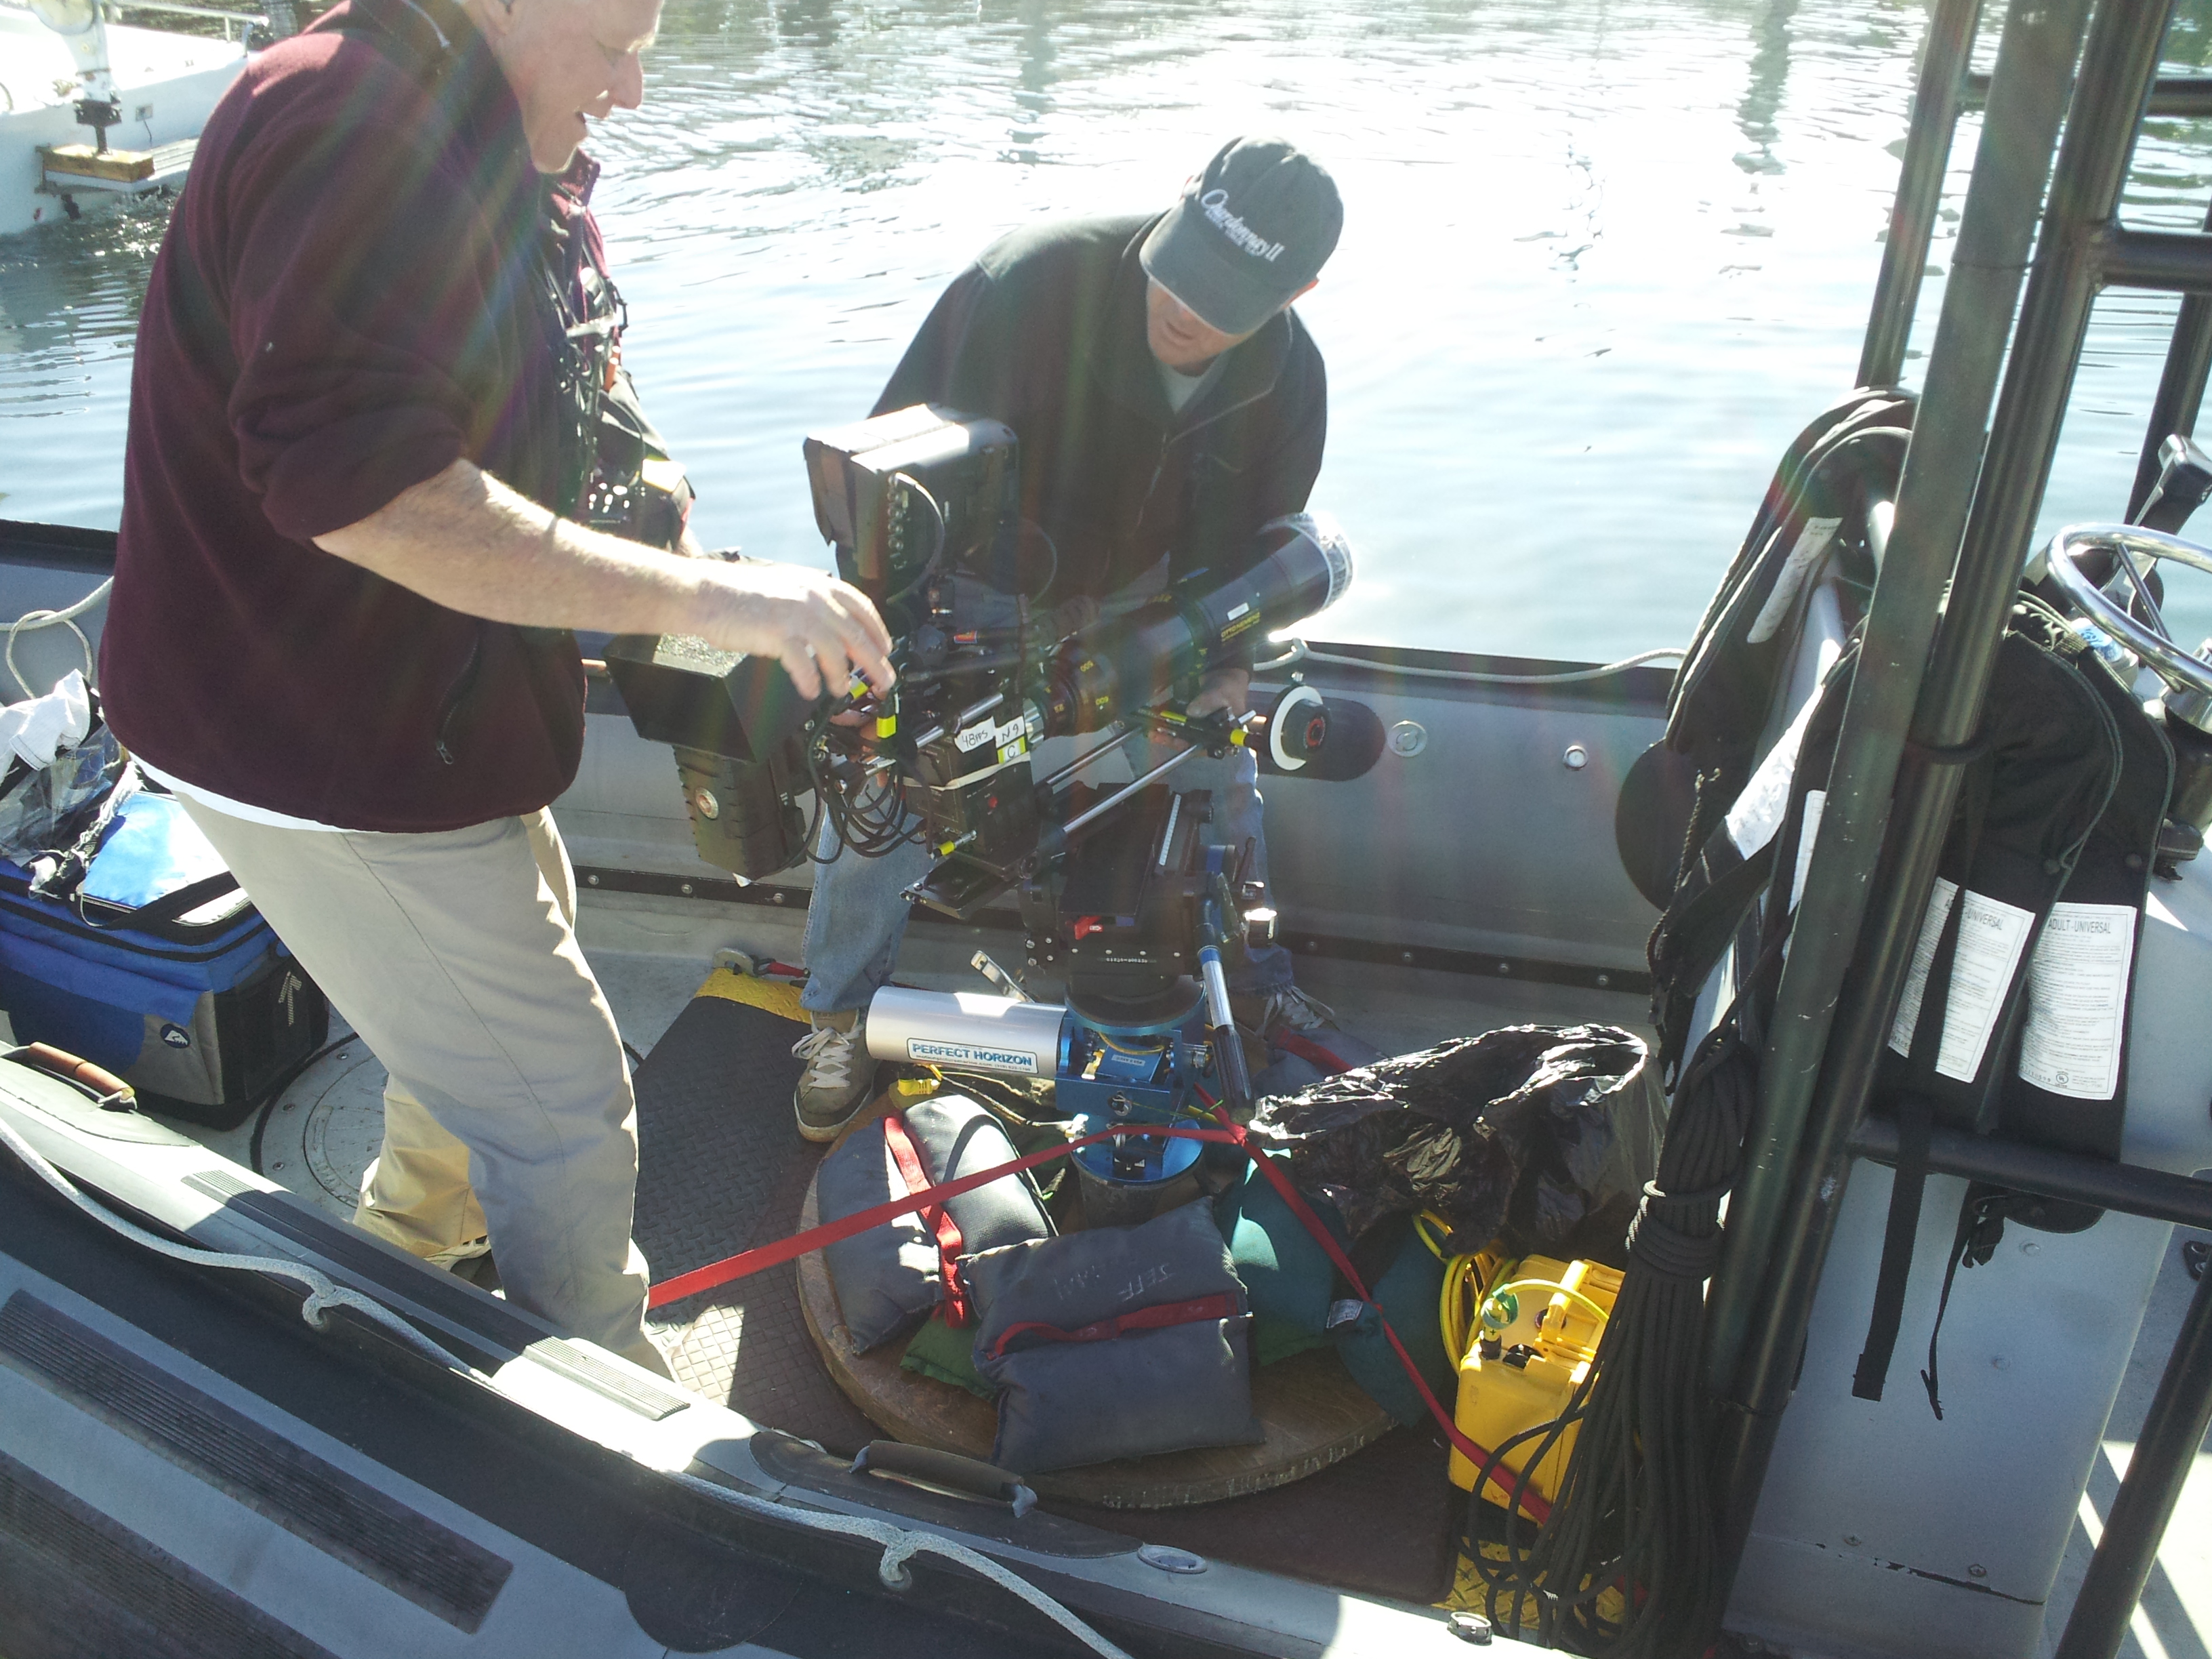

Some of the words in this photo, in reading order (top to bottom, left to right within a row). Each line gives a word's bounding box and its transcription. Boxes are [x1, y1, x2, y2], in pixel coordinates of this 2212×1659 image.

[962, 730, 987, 747] 48FPS
[1007, 745, 1016, 758] C
[913, 1044, 970, 1059] PERFECT
[974, 1050, 1032, 1066] HORIZON
